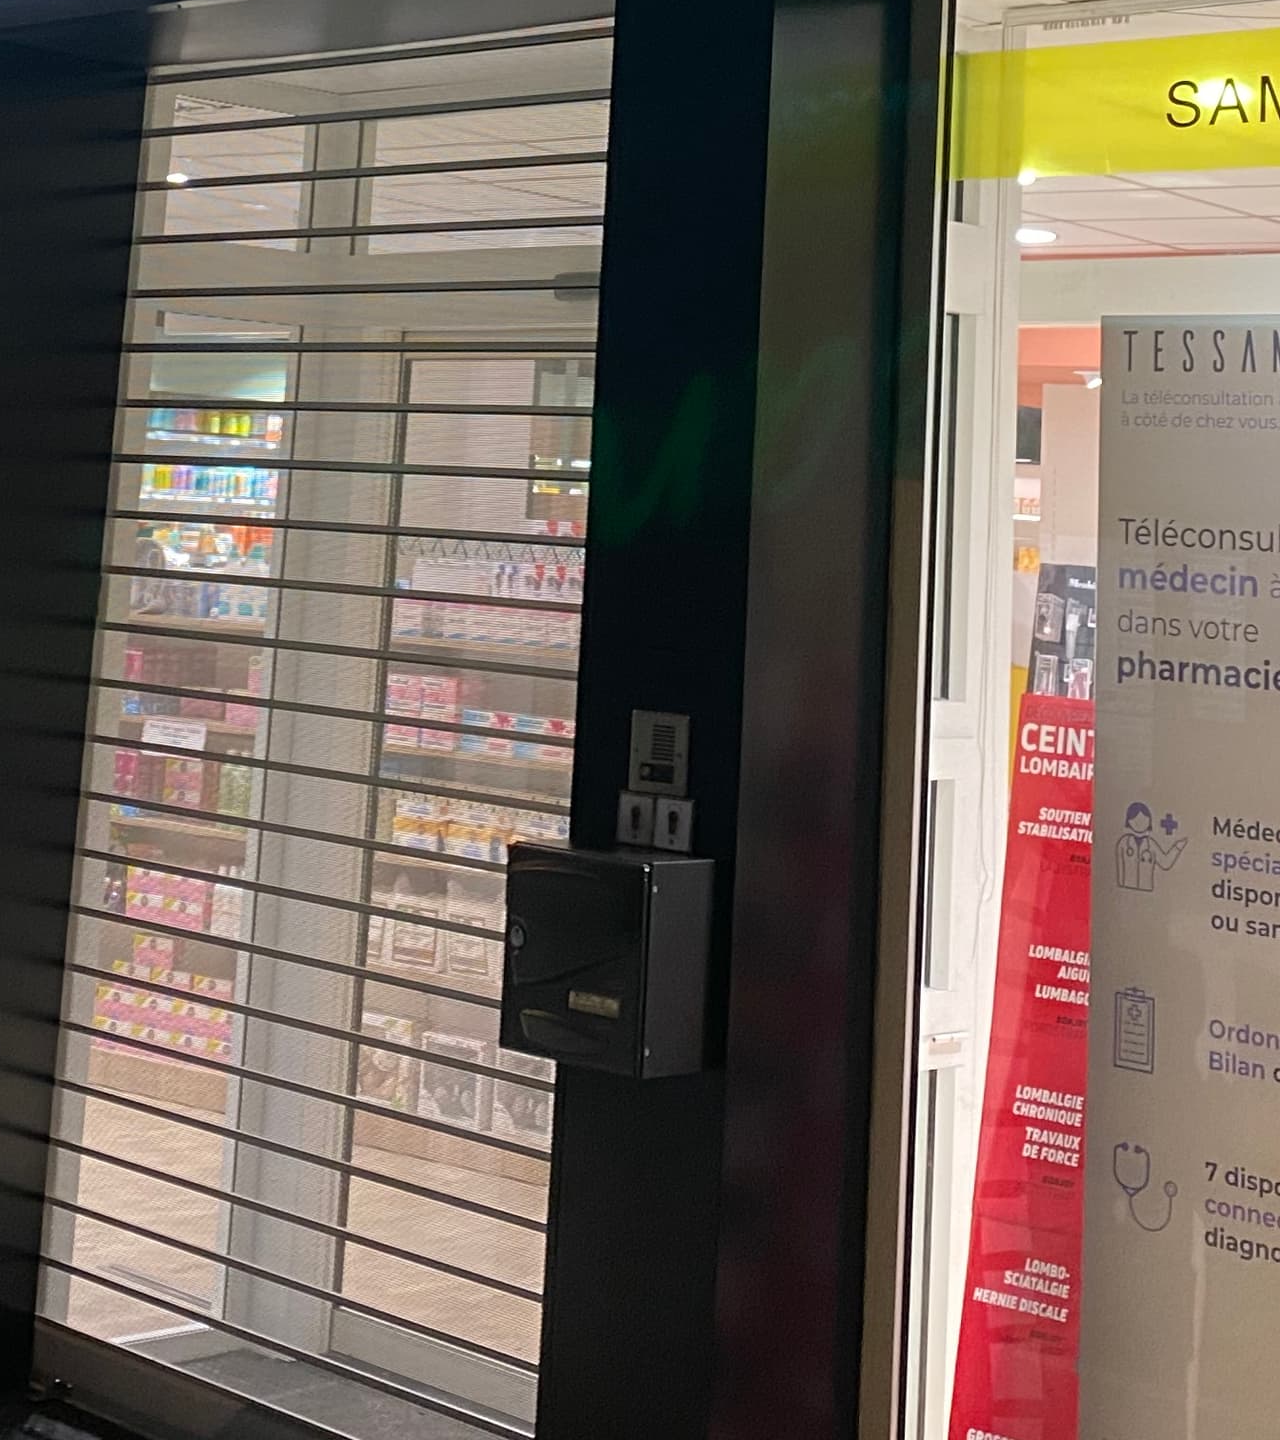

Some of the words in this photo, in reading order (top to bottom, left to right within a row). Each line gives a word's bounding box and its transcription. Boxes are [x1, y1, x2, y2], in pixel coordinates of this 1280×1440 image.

[1121, 390, 1140, 405] La
[1144, 389, 1274, 408] téléconsultation
[1121, 411, 1130, 427] à
[1134, 410, 1168, 428] côté
[1171, 412, 1193, 429] de
[1196, 413, 1233, 430] chez
[1118, 562, 1259, 598] médecin
[1117, 608, 1182, 638] dans
[1188, 618, 1260, 643] votre
[1038, 807, 1092, 827] SOUTIEN
[1210, 914, 1239, 934] ou
[1028, 943, 1091, 966] LOMBALGI
[1208, 1050, 1266, 1081] Bilan
[1015, 1084, 1085, 1111] LOMBALGIE
[1012, 1101, 1083, 1128] CHRONIQUE
[1024, 1126, 1082, 1151] TRAVAUX
[1021, 1142, 1039, 1160] DE
[1039, 1146, 1081, 1168] FORCE
[1204, 1161, 1218, 1182] 7
[1024, 1257, 1071, 1281] LOMBO-
[1003, 1269, 1071, 1300] SCIATALGIE
[972, 1286, 1019, 1310] HERNIE
[1018, 1298, 1070, 1323] DISCALE
